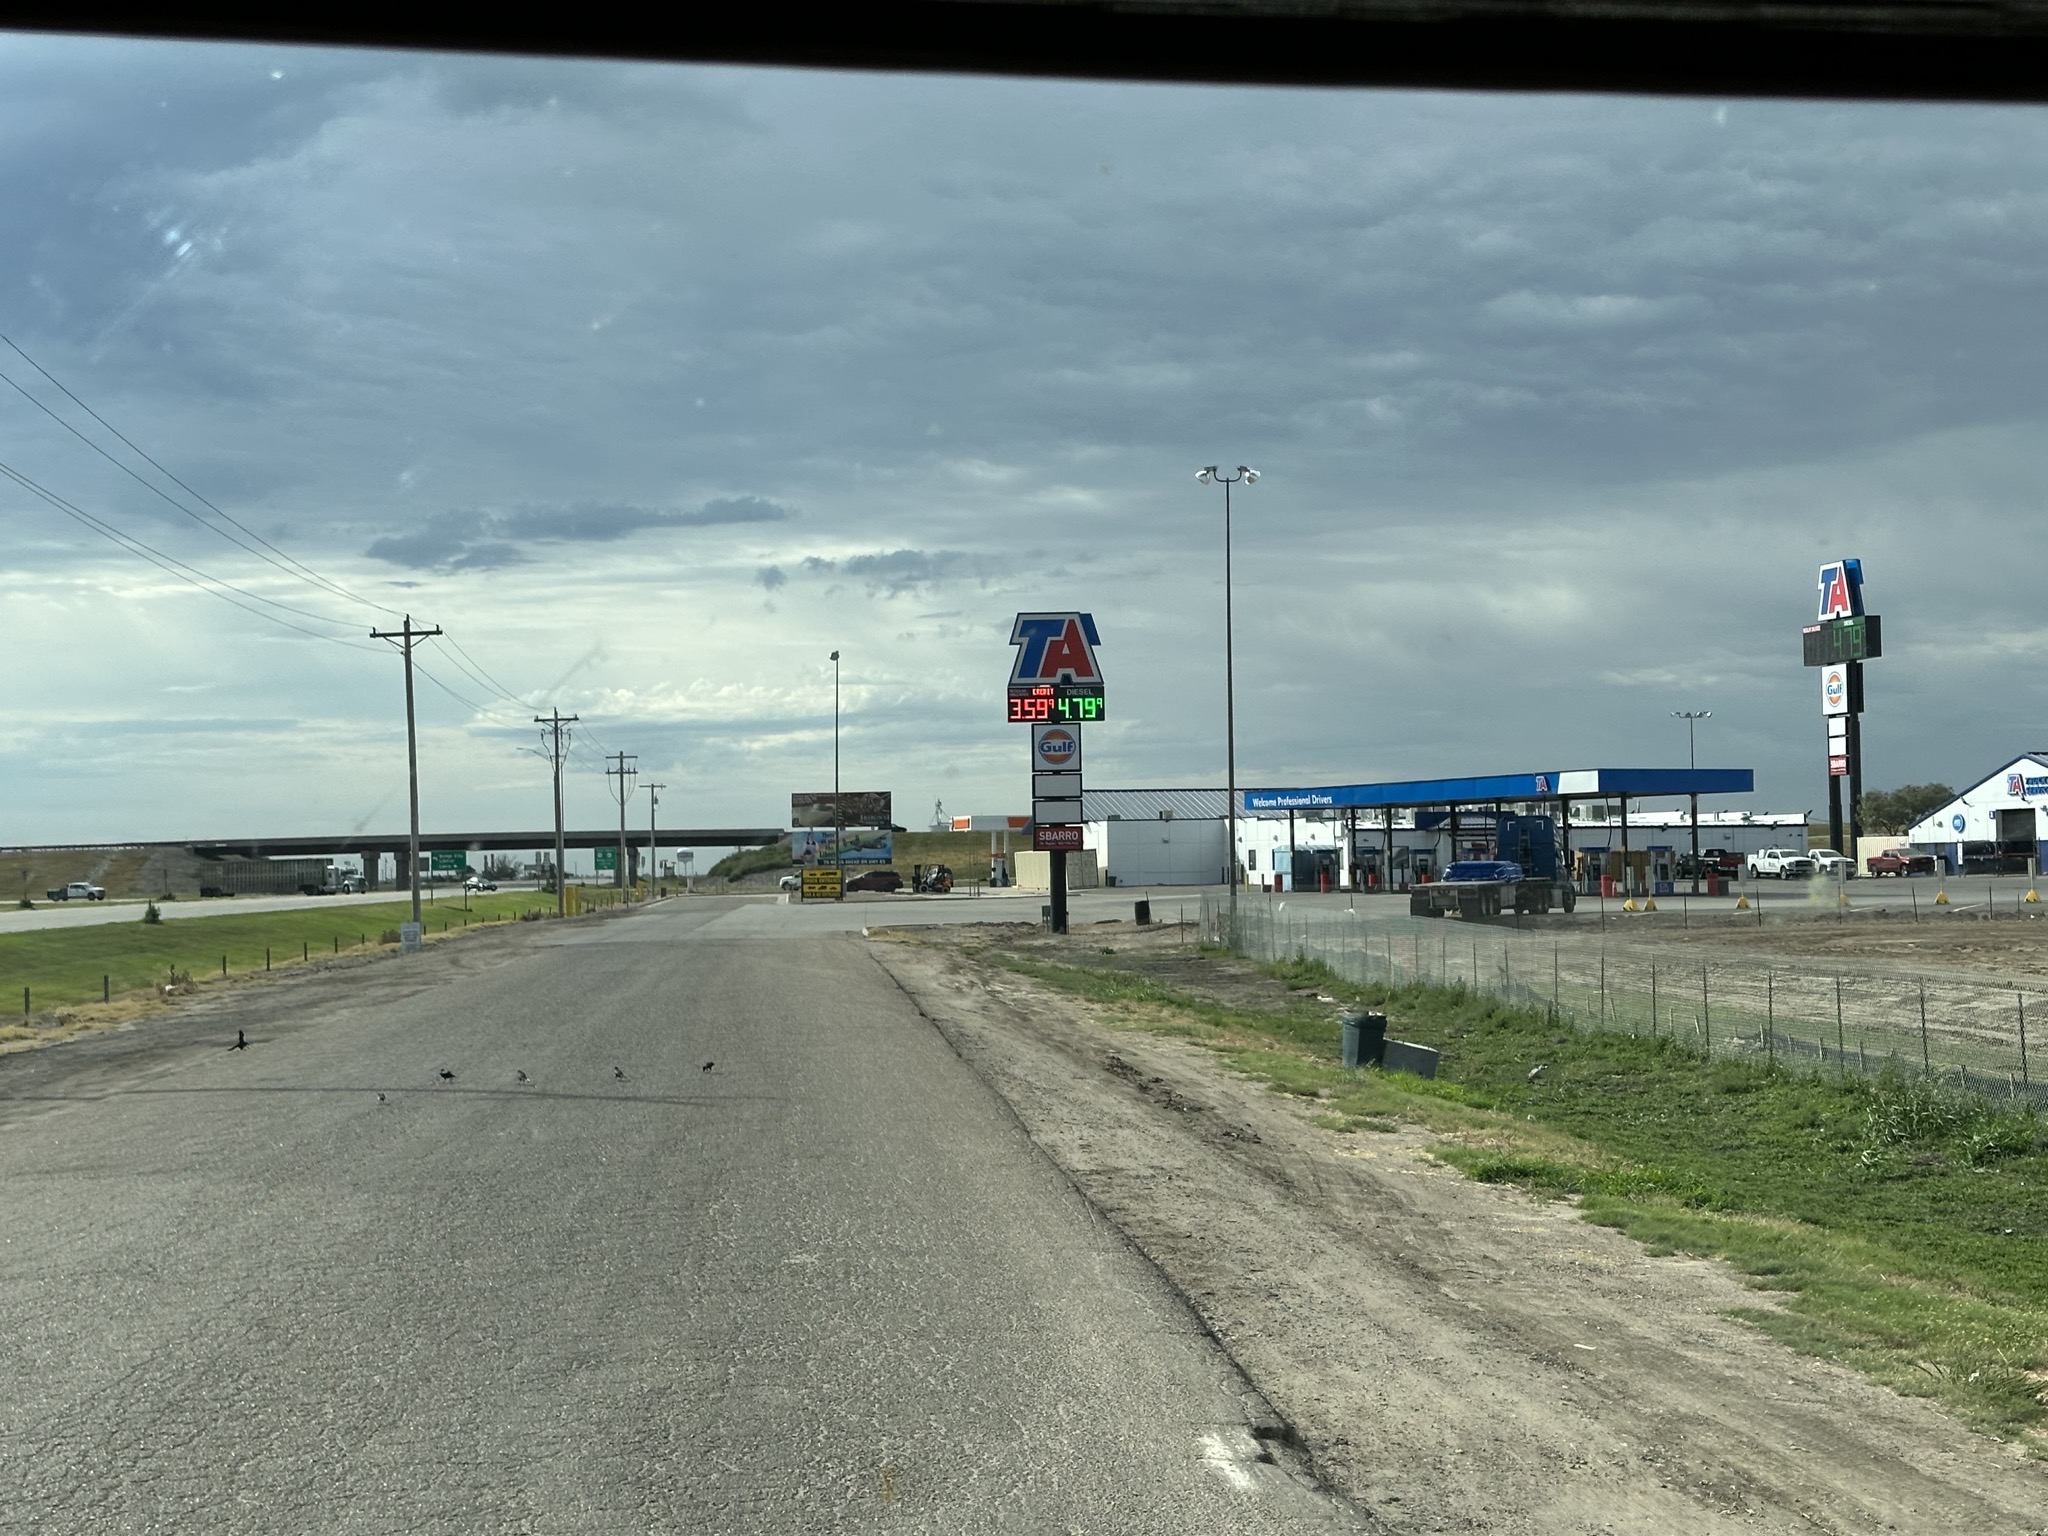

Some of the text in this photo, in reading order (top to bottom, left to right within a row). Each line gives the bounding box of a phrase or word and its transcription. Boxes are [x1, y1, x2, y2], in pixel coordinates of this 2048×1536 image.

[1819, 564, 1851, 618] TA
[1014, 615, 1099, 681] TA
[1066, 688, 1093, 696] DIESEL
[1827, 683, 1843, 695] Gulf
[1040, 741, 1075, 754] Gulf
[2008, 774, 2024, 793] TA
[1252, 794, 1332, 808] Welcome Professional Drivers
[1039, 831, 1078, 841] SBARRO
